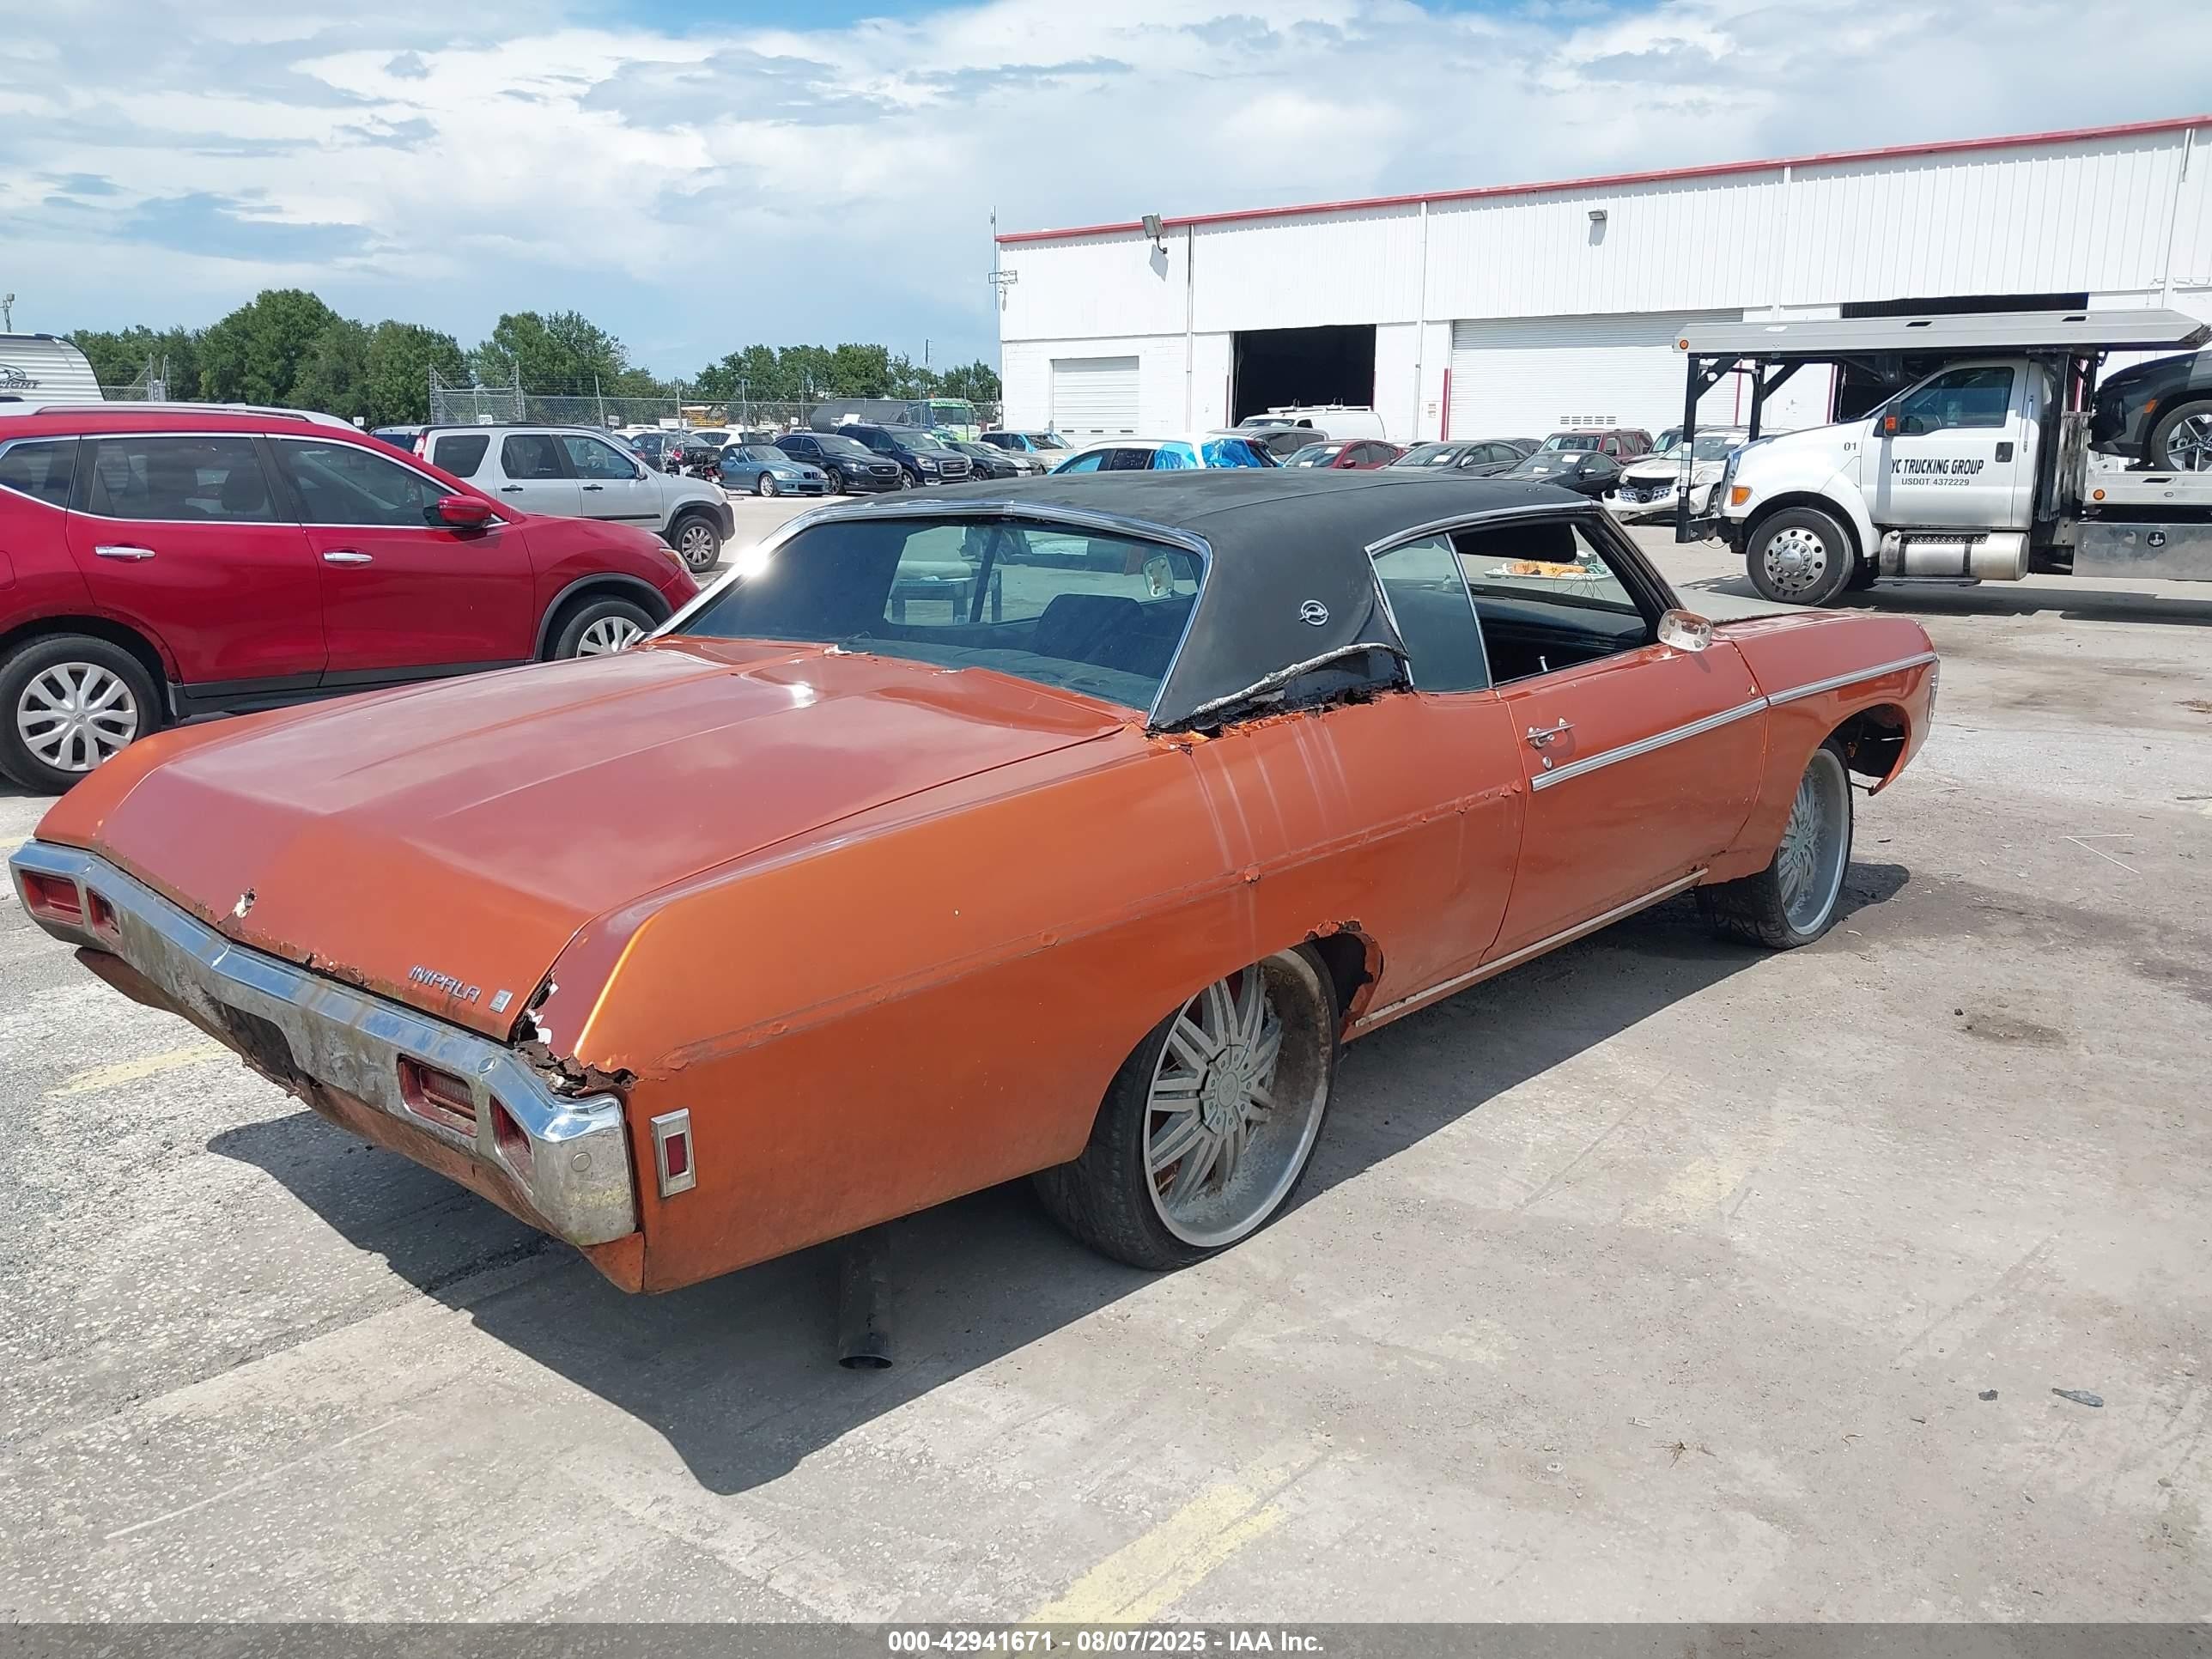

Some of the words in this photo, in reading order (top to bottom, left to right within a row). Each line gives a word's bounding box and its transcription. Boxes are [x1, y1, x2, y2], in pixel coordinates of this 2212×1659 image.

[1844, 441, 1857, 452] 01
[1904, 459, 1949, 475] TRUCKING
[1950, 459, 1984, 475] GROUP
[1901, 477, 1931, 486] USDOT
[1932, 477, 1970, 486] 4372229
[408, 964, 482, 1005] IMPALA
